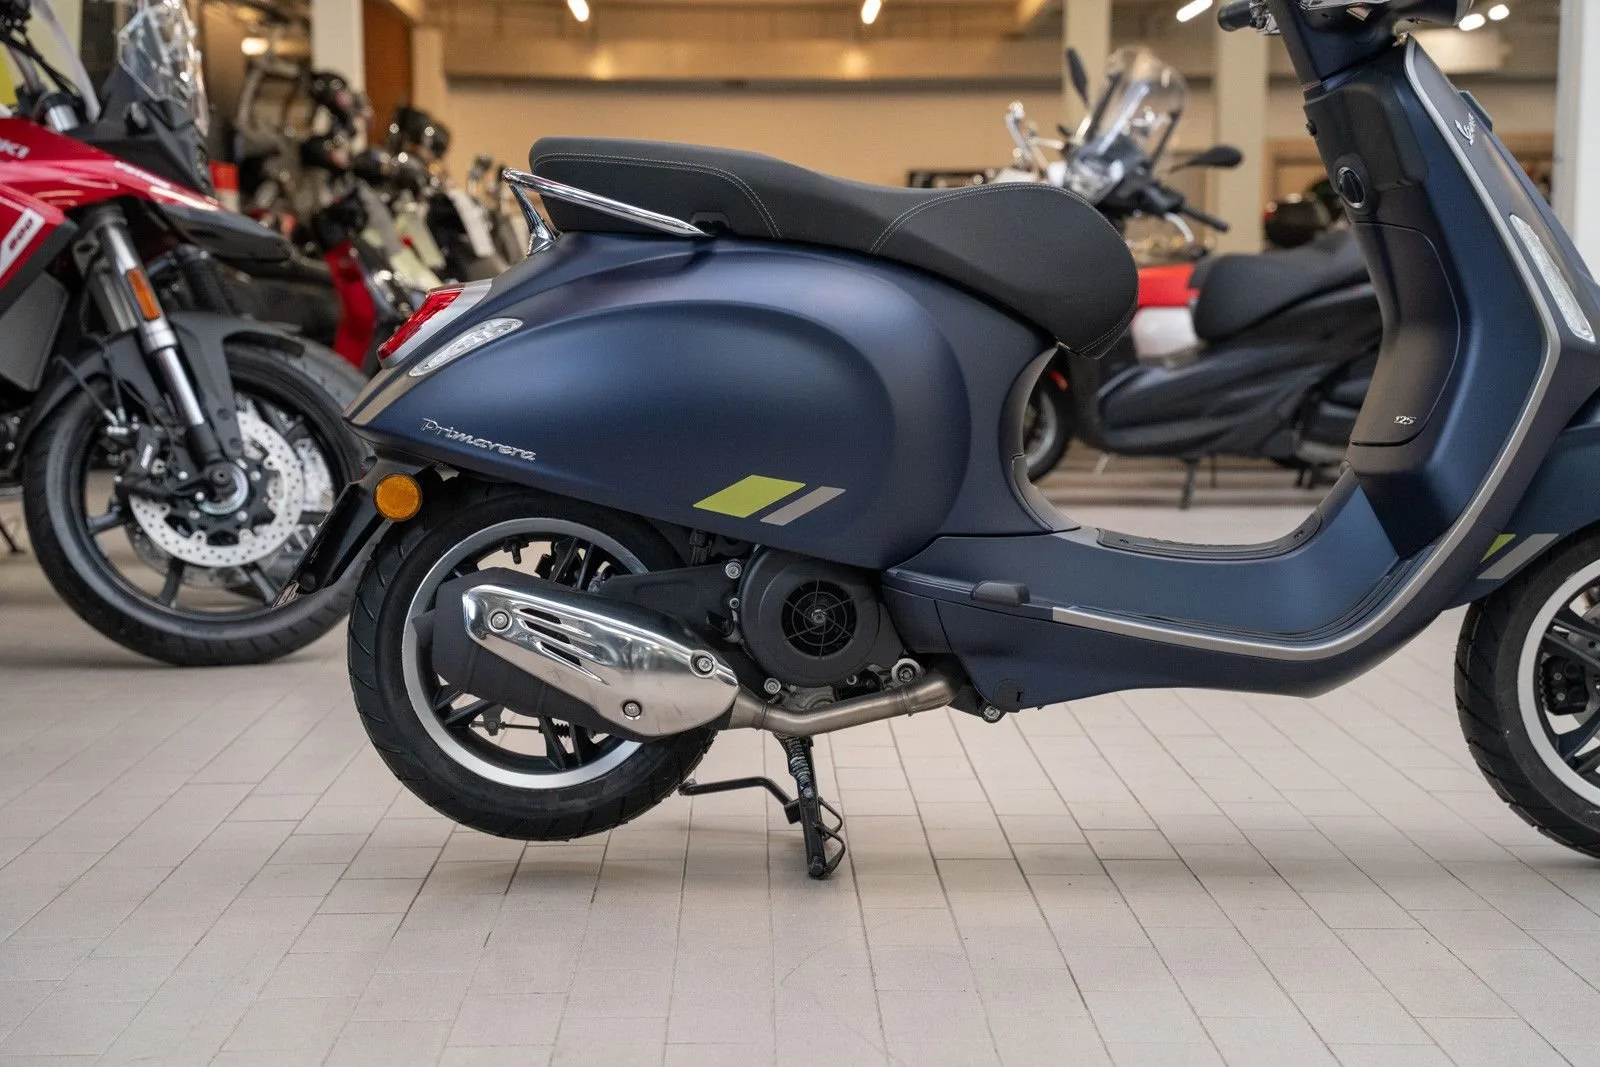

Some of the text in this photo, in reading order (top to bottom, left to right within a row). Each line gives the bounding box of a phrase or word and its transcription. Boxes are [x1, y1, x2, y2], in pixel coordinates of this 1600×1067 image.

[0, 137, 31, 159] KI
[1393, 415, 1417, 425] 125
[421, 417, 537, 461] Primavera
